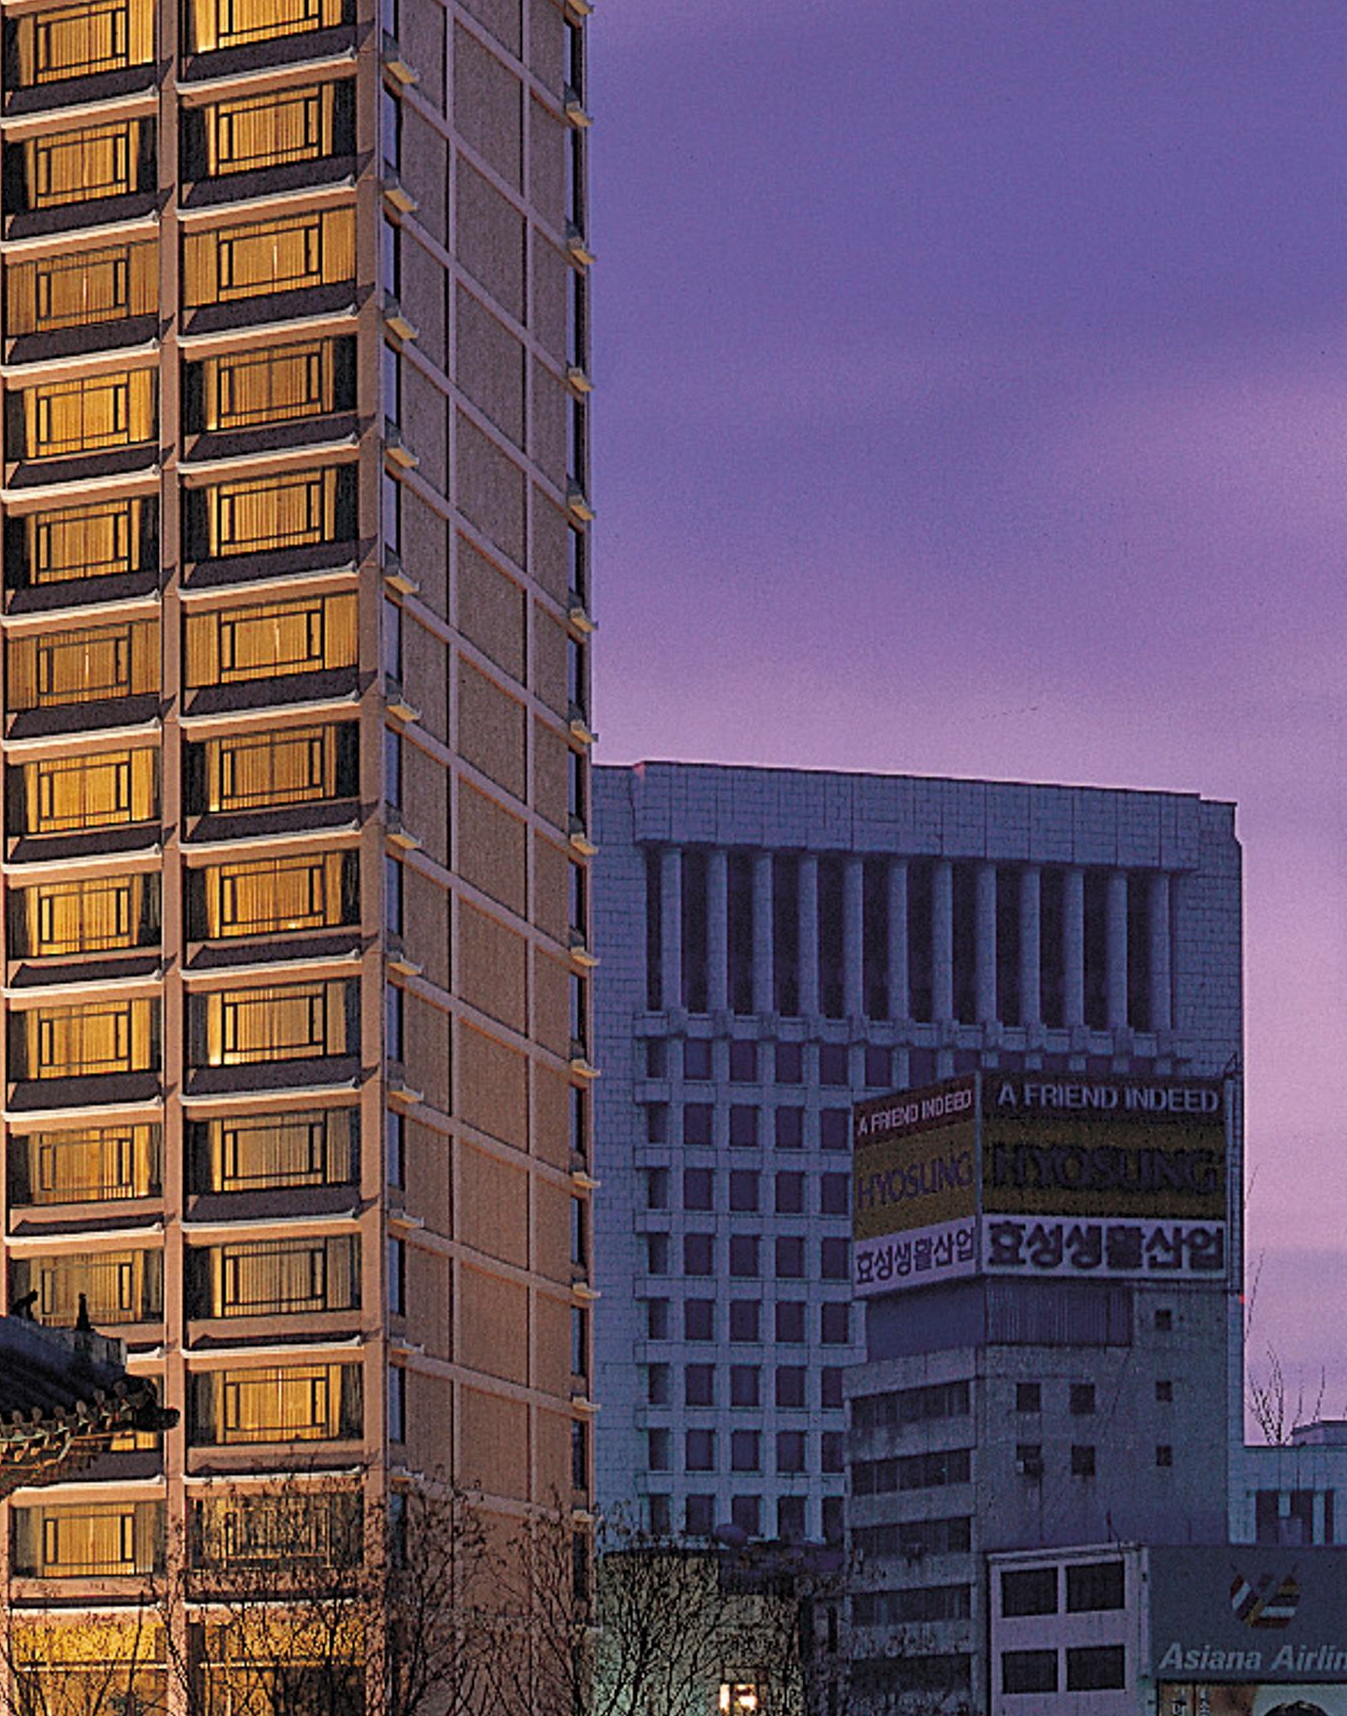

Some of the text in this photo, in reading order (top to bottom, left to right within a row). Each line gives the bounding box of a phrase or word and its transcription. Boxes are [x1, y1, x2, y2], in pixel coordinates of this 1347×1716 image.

[858, 1089, 973, 1135] A FRIEND INDEED
[997, 1082, 1219, 1114] A FRIEND INDEED
[857, 1151, 973, 1210] HYOSUNG
[991, 1144, 1219, 1196] HYOSUNG
[856, 1227, 976, 1285] 효성생활산업
[988, 1221, 1224, 1271] 효성생활산업
[1158, 1641, 1262, 1671] Asiana
